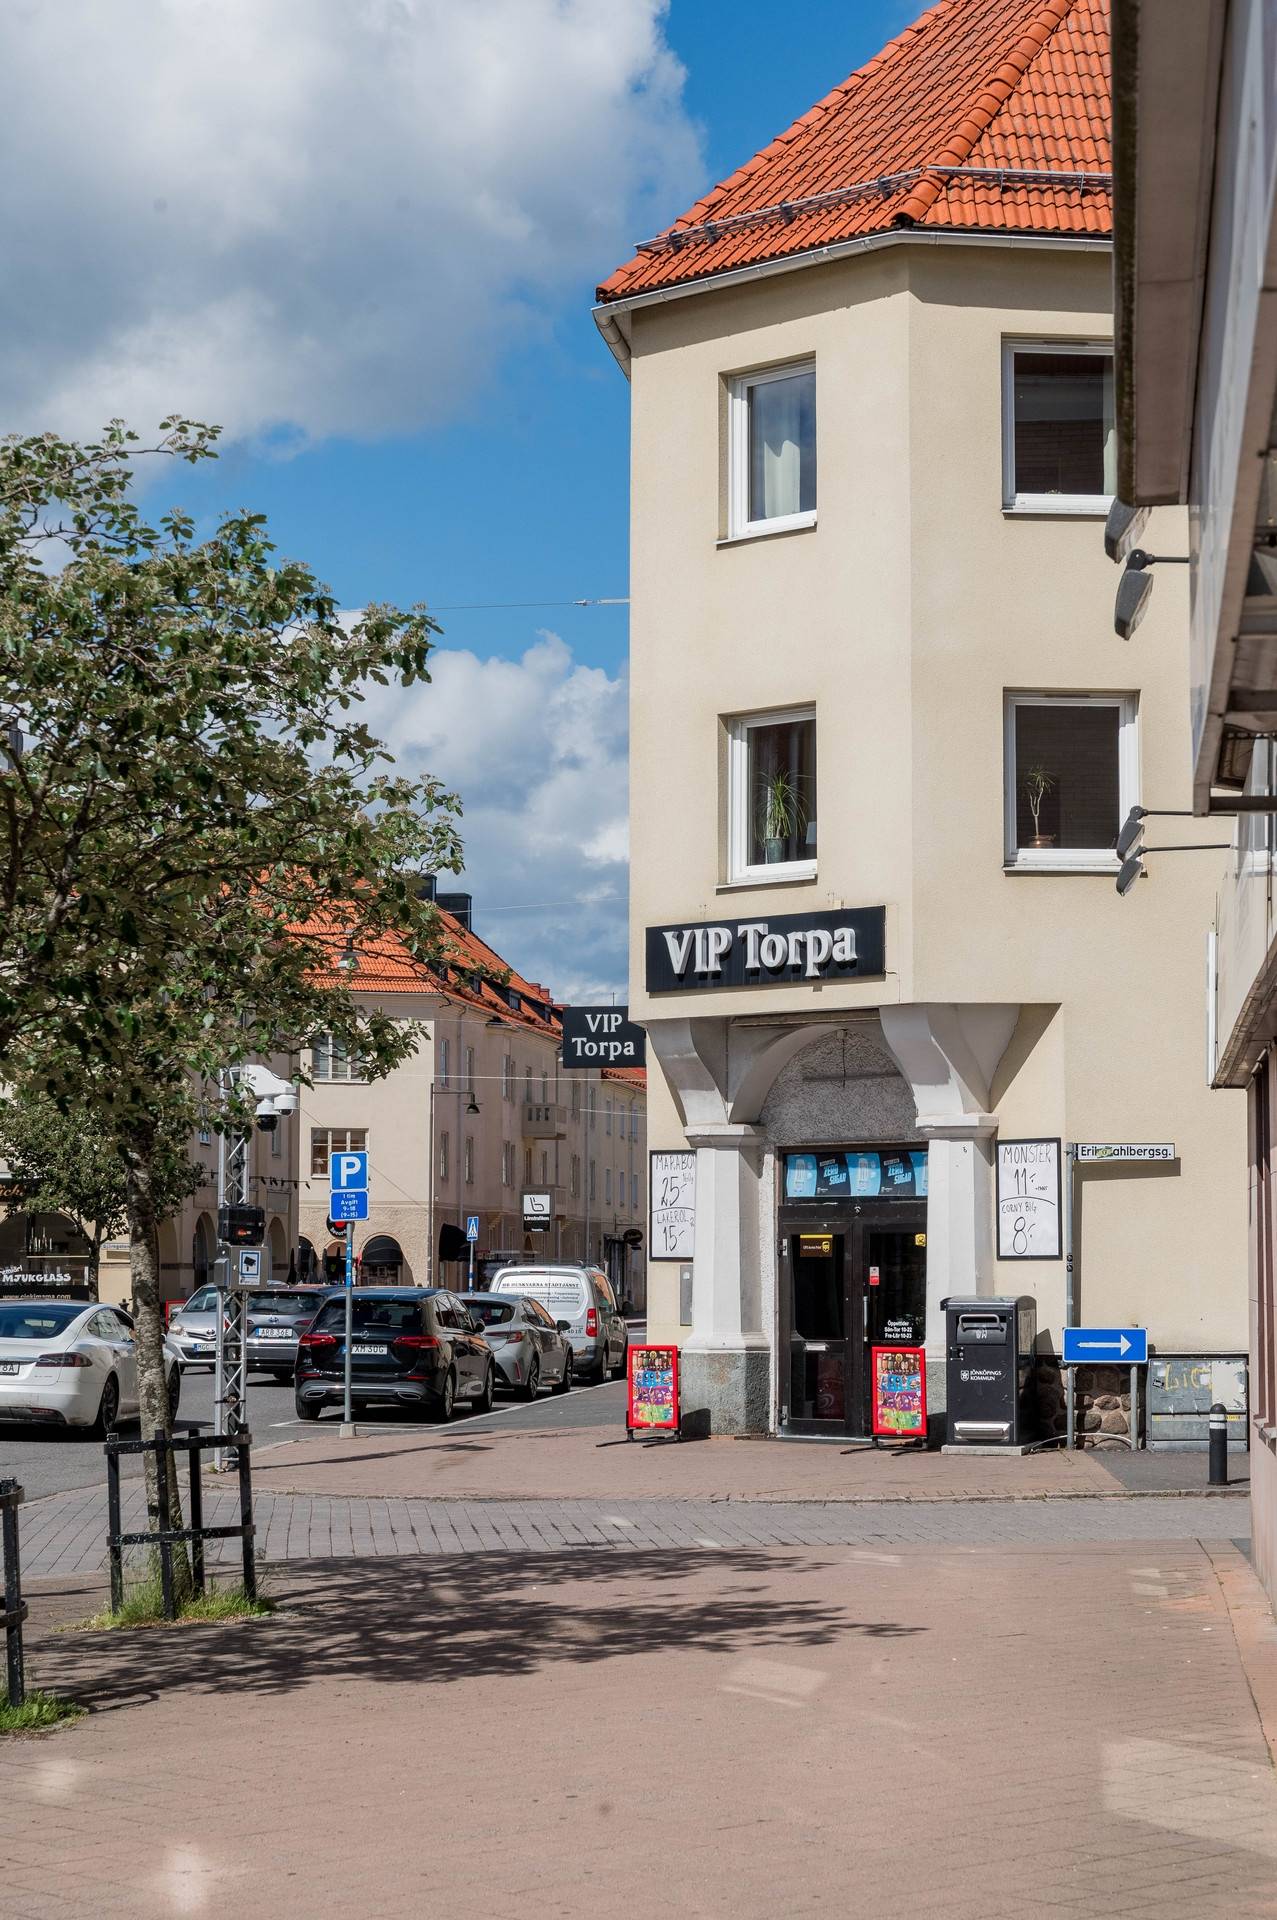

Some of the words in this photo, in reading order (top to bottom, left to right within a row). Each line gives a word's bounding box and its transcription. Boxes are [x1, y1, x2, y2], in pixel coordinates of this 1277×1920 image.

[662, 927, 732, 975] VIP
[738, 923, 858, 977] Torpa
[585, 1013, 622, 1033] VIP
[571, 1037, 635, 1061] Torpa
[1003, 1144, 1051, 1164] MONSTER
[1106, 1146, 1172, 1158] ahlbergsg.
[340, 1156, 361, 1187] P
[894, 1172, 912, 1185] SUGAR
[1002, 1203, 1022, 1214] CORNY
[2, 1273, 71, 1282] MJUKGLASS
[887, 1319, 909, 1327] Öppettider
